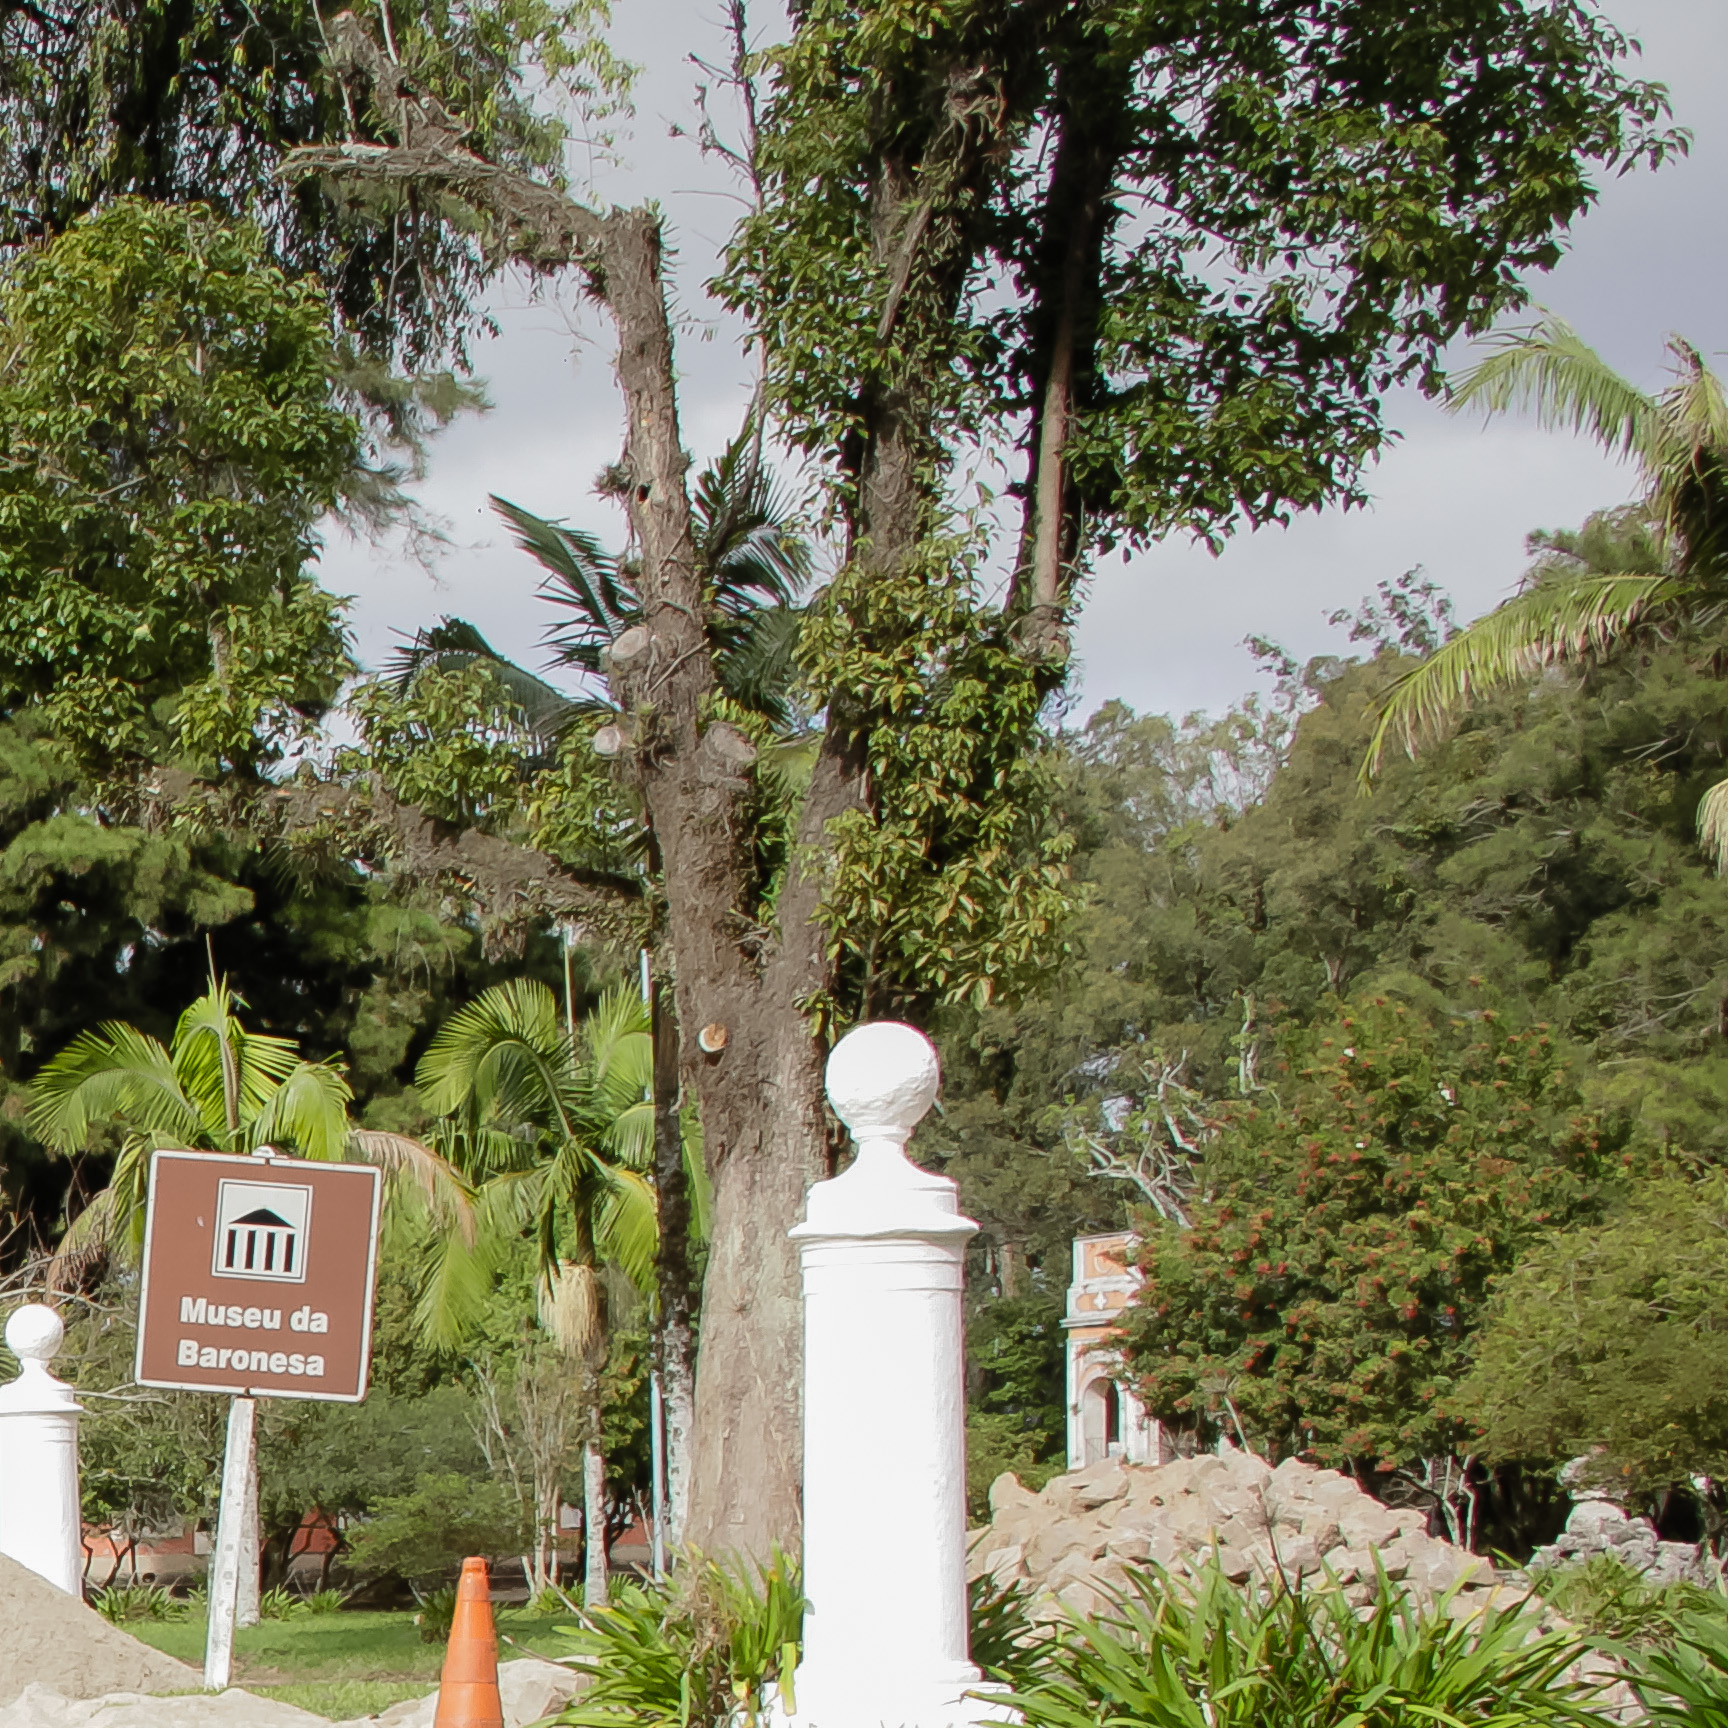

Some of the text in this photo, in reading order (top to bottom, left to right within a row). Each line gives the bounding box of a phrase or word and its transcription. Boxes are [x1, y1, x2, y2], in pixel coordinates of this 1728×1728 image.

[180, 1296, 329, 1333] Museu da
[177, 1339, 325, 1376] Baronesa
